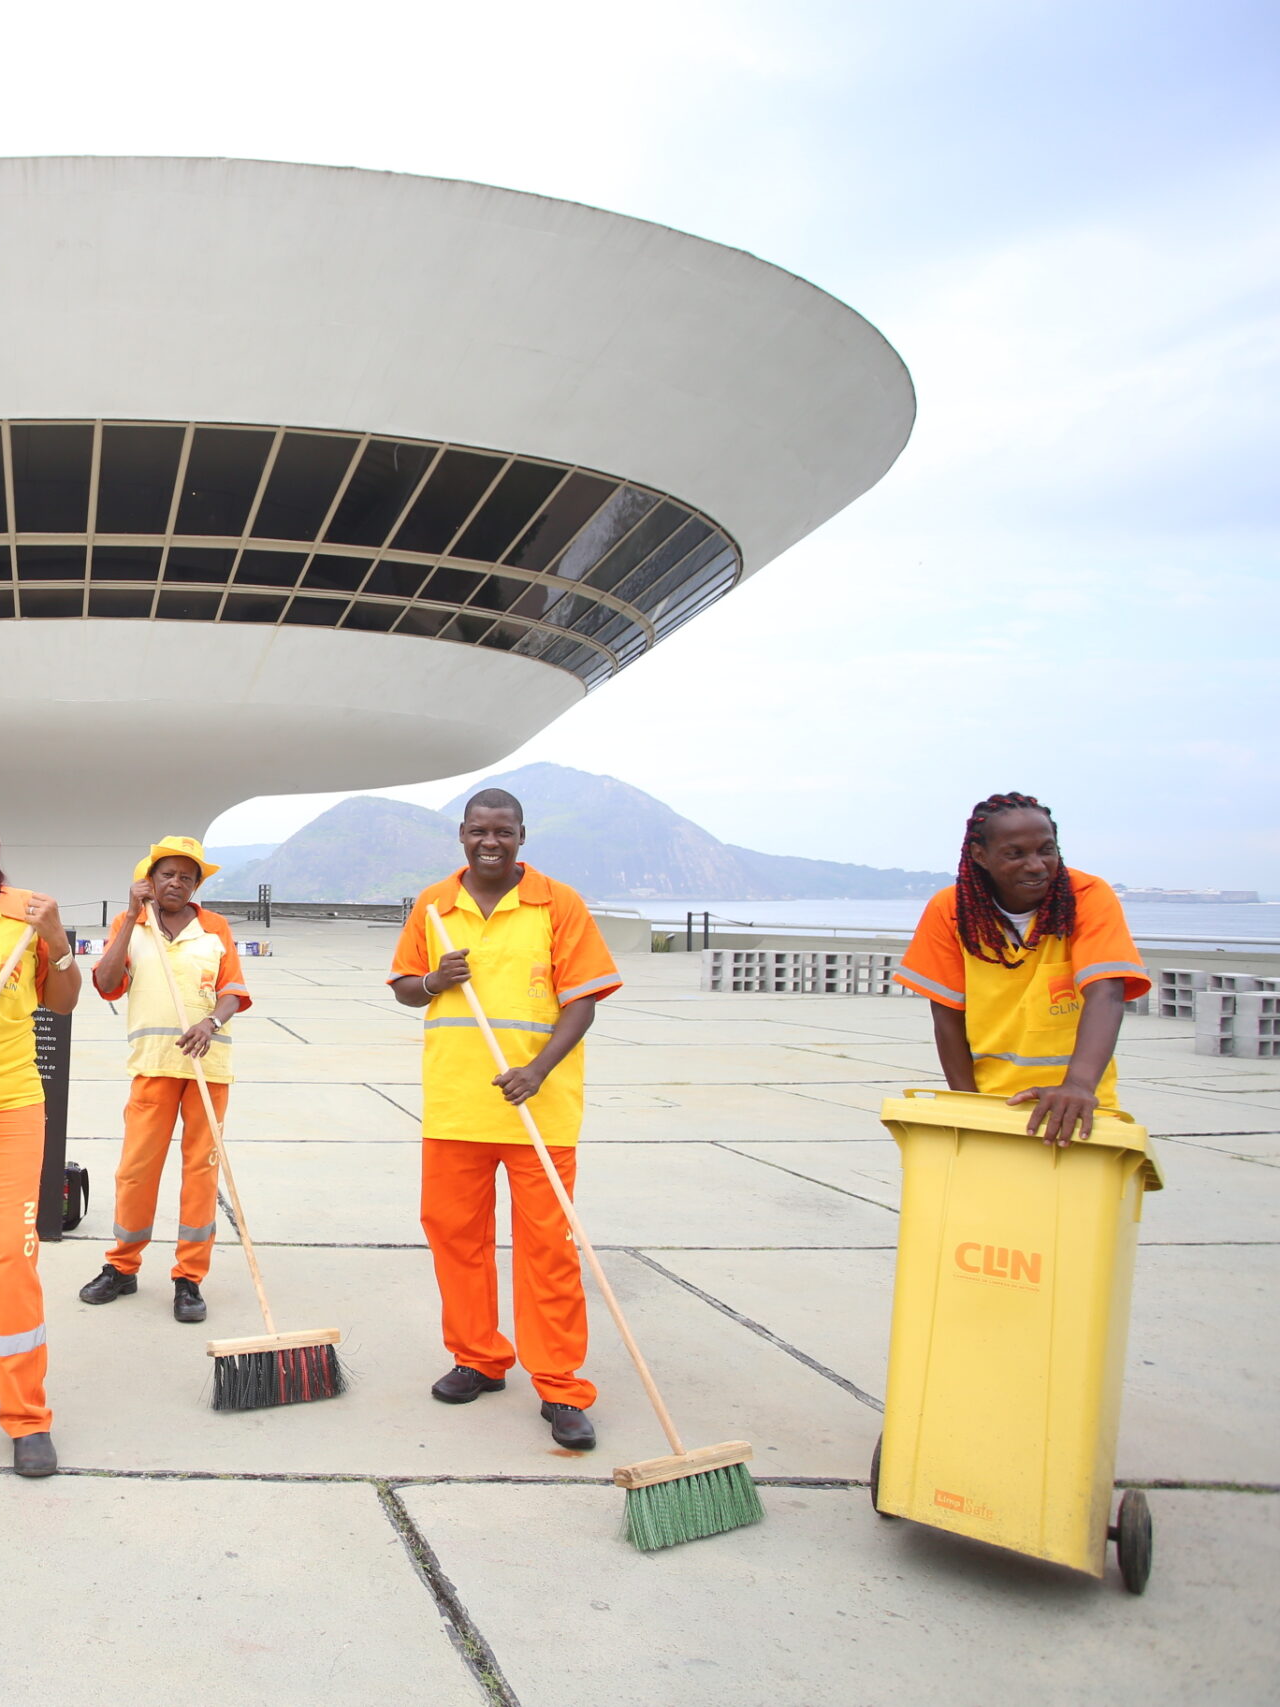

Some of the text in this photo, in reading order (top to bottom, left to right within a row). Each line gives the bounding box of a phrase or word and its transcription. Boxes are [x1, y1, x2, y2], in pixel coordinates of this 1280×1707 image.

[1049, 1001, 1079, 1016] CLIN
[23, 1201, 36, 1257] CLIN
[954, 1241, 1042, 1284] CLIN
